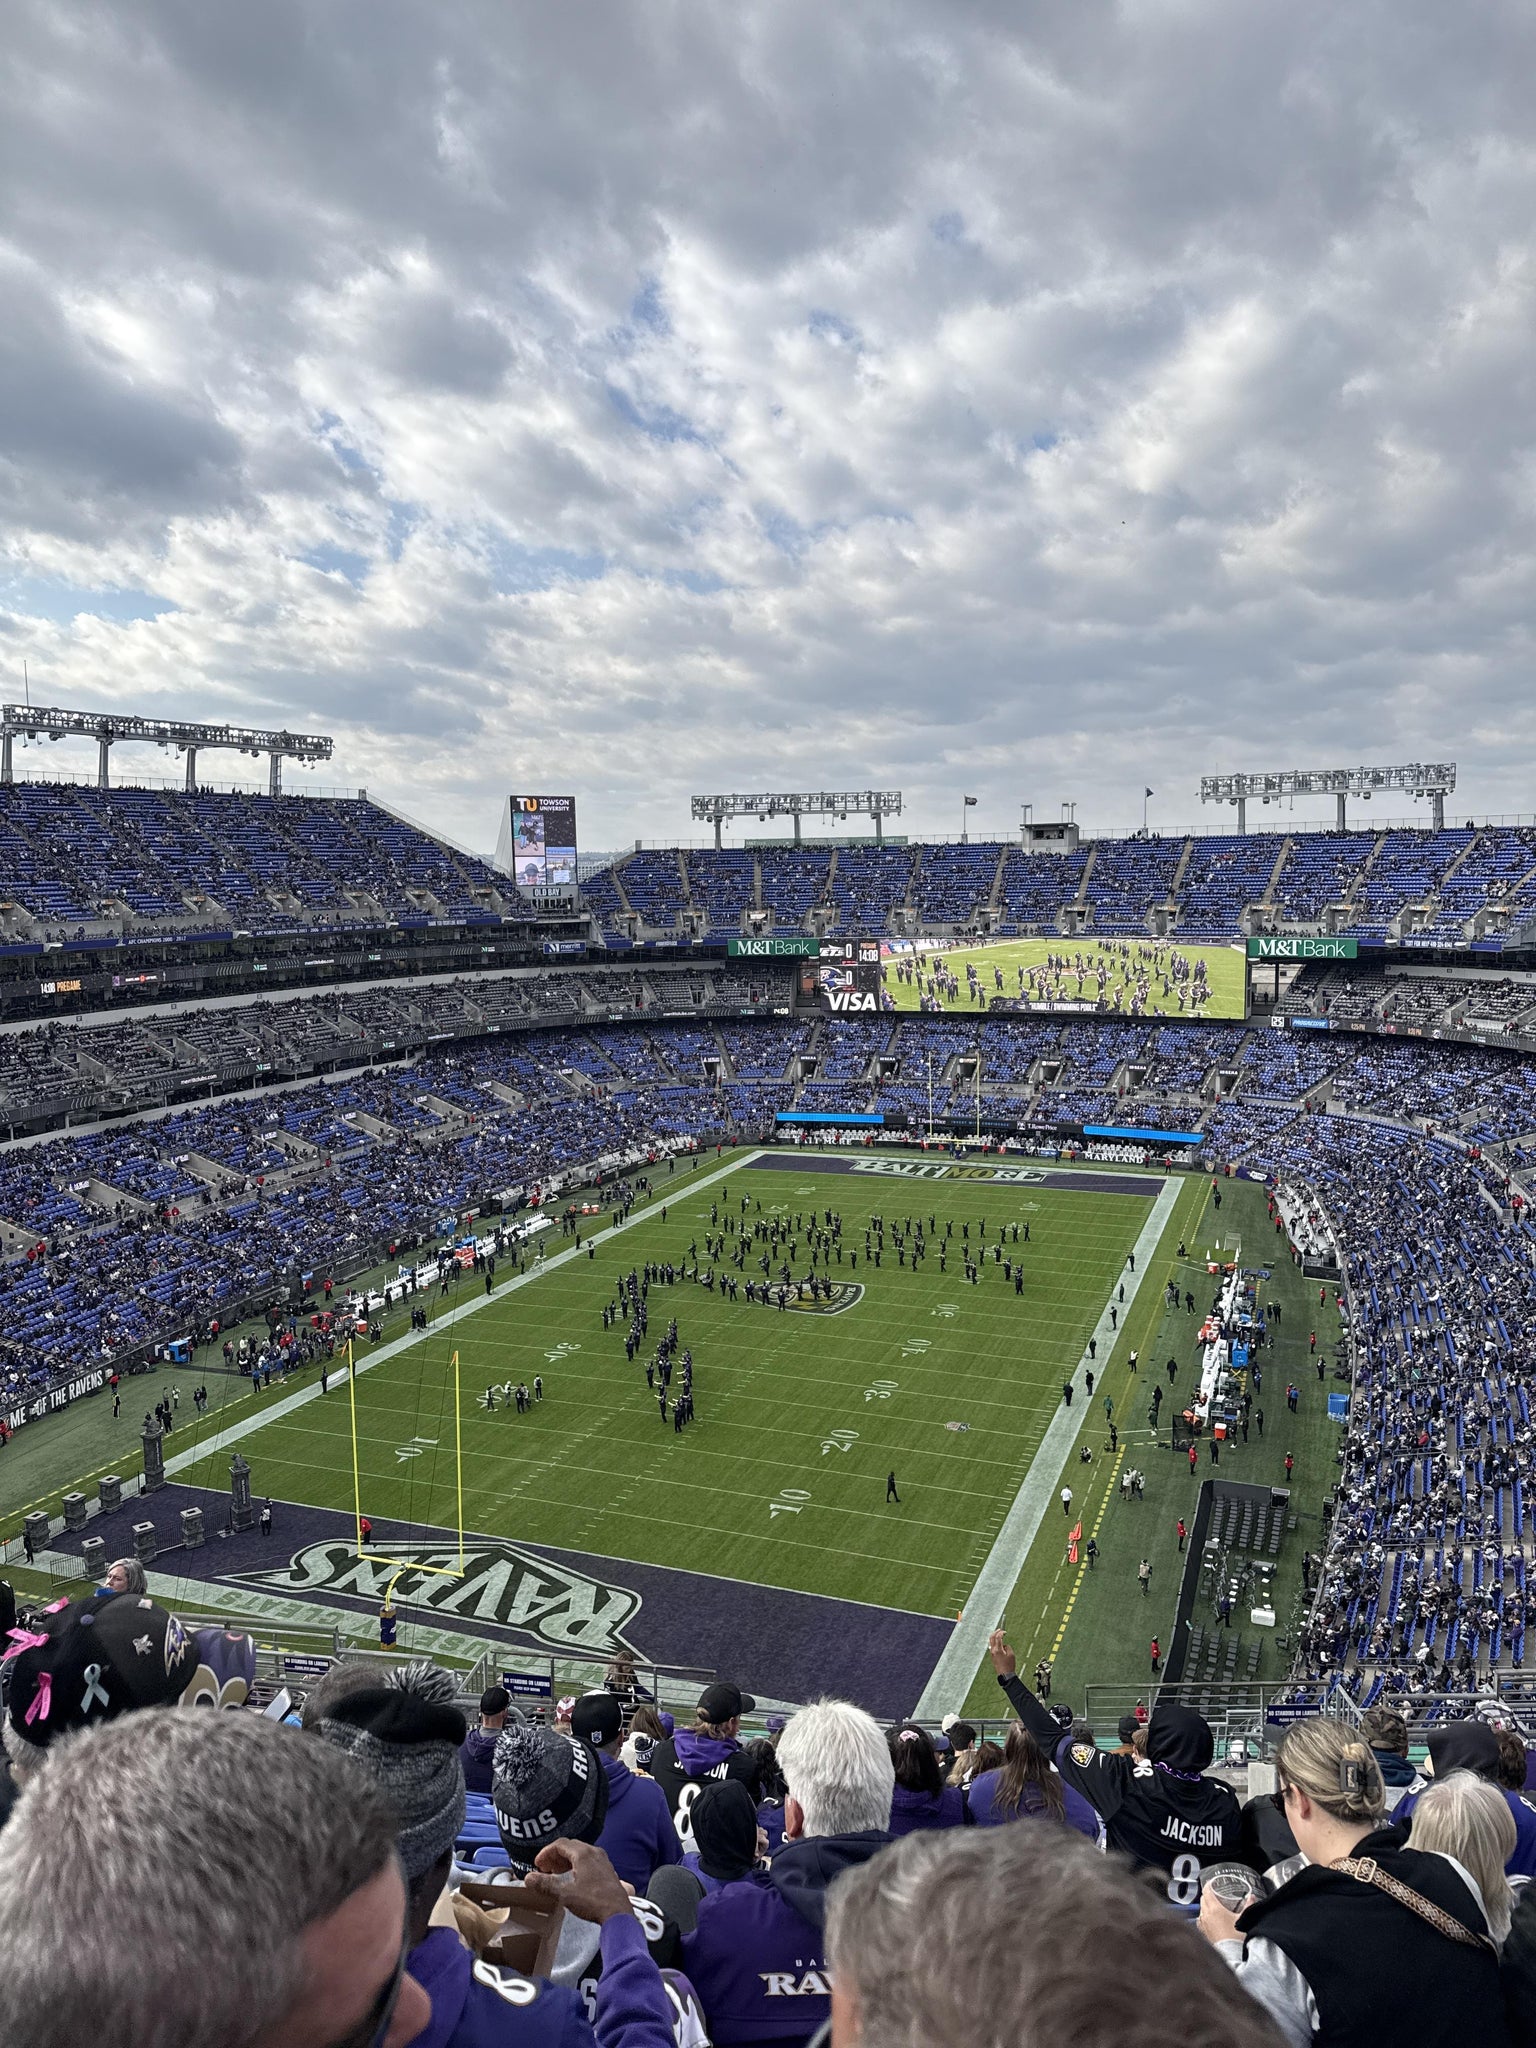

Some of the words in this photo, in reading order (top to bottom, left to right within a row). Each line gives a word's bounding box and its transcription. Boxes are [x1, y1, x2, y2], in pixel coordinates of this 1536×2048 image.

[516, 797, 538, 812] TU
[534, 888, 546, 896] OLD
[547, 888, 560, 896] BAY
[736, 940, 774, 956] M&T
[774, 940, 810, 955] Bank
[846, 944, 853, 959] 0
[859, 950, 878, 962] 14:08
[1258, 939, 1302, 956] M&T
[1303, 940, 1346, 957] Bank
[846, 970, 853, 986] 0
[40, 982, 55, 994] 14:08
[56, 980, 82, 992] PREGAME
[824, 992, 877, 1011] VISA
[1054, 1002, 1079, 1011] SWIMMING
[180, 1074, 218, 1085] merrittclubs.com
[1084, 1152, 1144, 1165] MARYLAND
[856, 1160, 1047, 1182] BALTIMORE
[544, 1342, 582, 1359] 30
[901, 1338, 932, 1354] 40
[864, 1380, 899, 1399] 30
[10, 1406, 26, 1429] ME
[36, 1396, 47, 1416] OF
[50, 1387, 67, 1408] THE
[69, 1370, 103, 1400] RAVENS
[394, 1436, 440, 1452] 10
[820, 1429, 860, 1453] 20
[770, 1488, 812, 1515] 10
[258, 1543, 634, 1650] RAVENS
[215, 1591, 344, 1626] CLEATS
[496, 1802, 558, 1839] VENS
[1160, 1816, 1222, 1846] JACKSON
[1167, 1854, 1201, 1905] 8
[795, 1958, 830, 1967] BAL
[473, 1958, 538, 2007] 8
[757, 1970, 834, 1996] RAV
